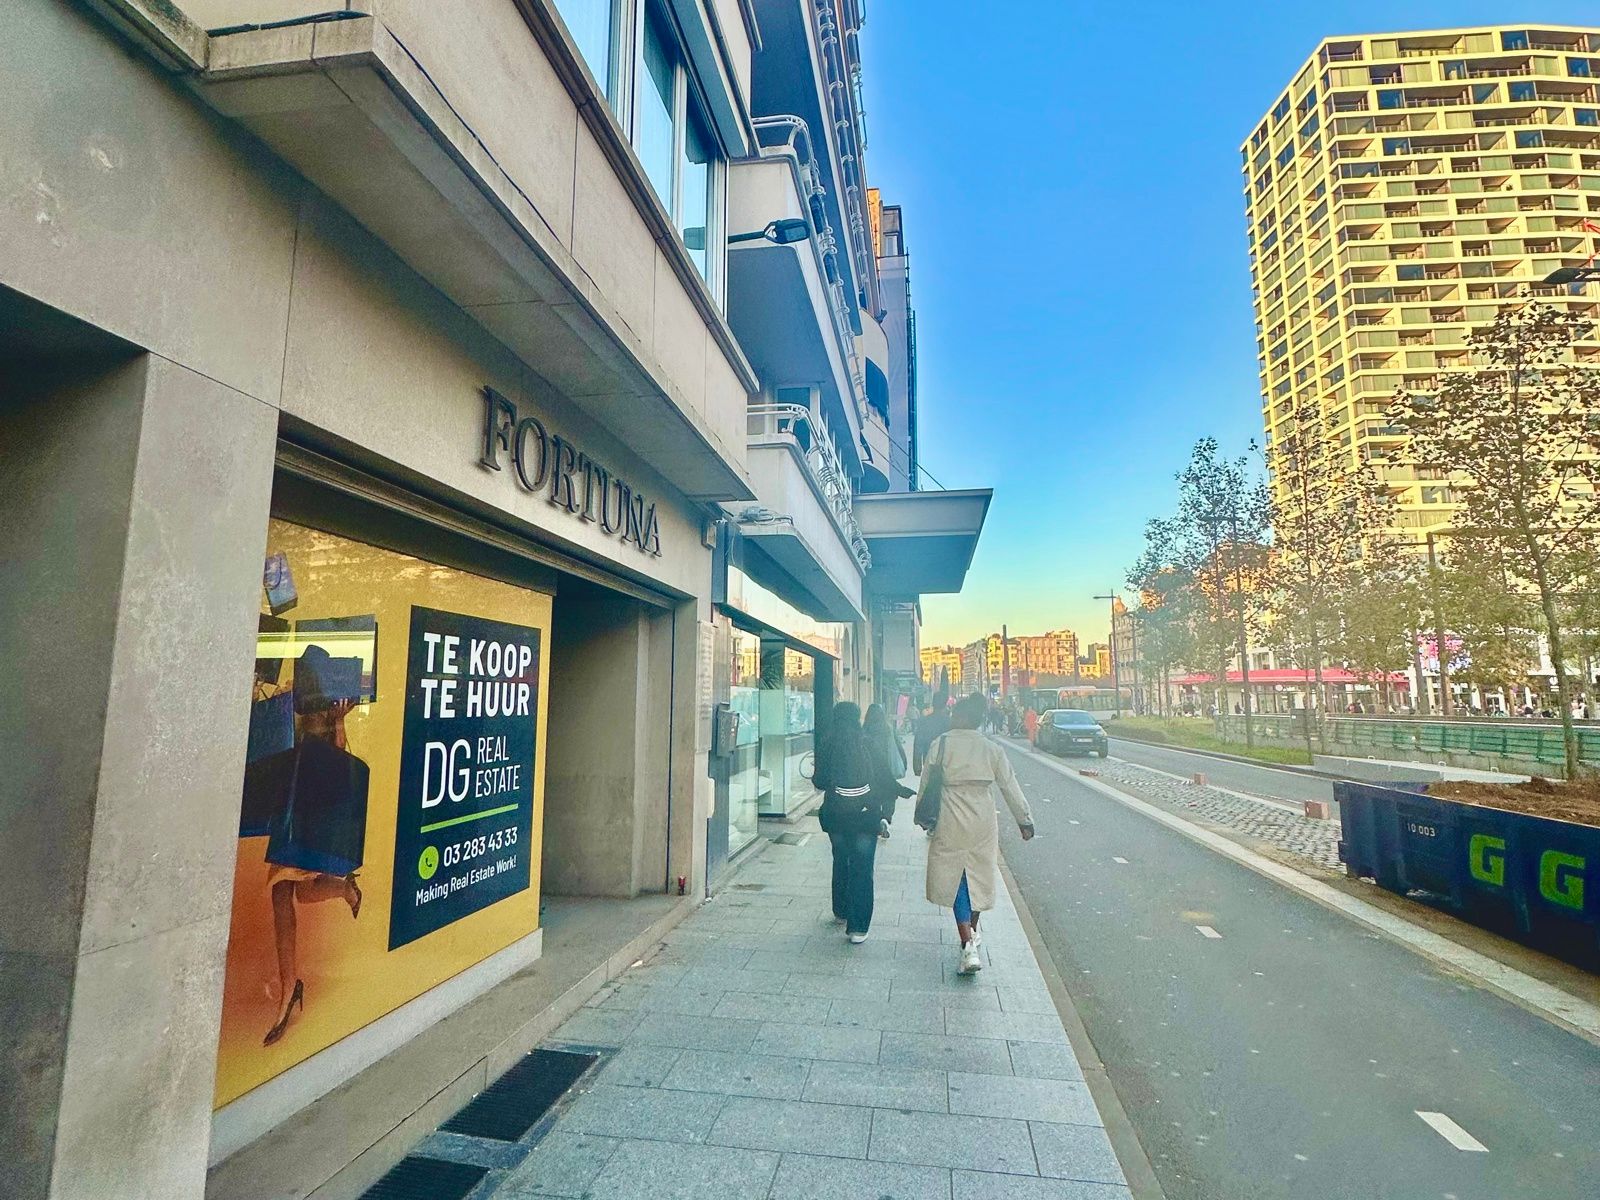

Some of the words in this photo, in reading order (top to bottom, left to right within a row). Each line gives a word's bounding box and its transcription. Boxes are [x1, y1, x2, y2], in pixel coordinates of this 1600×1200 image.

[481, 384, 662, 557] FORTUNA
[424, 632, 460, 675] TE
[469, 638, 532, 678] KOOP
[421, 678, 457, 719] TE
[466, 681, 530, 717] HUUR
[477, 735, 509, 764] REAL
[421, 738, 471, 809] DG
[475, 764, 521, 798] ESTATE
[443, 843, 461, 867] 03
[463, 835, 486, 860] 283
[488, 830, 503, 852] 43
[504, 826, 518, 847] 33
[1418, 825, 1436, 837] 003
[415, 882, 449, 907] Making
[450, 872, 469, 893] Real
[470, 864, 495, 885] Estate
[496, 854, 517, 875] Work!
[1469, 833, 1505, 887] G
[1540, 849, 1586, 910] G
